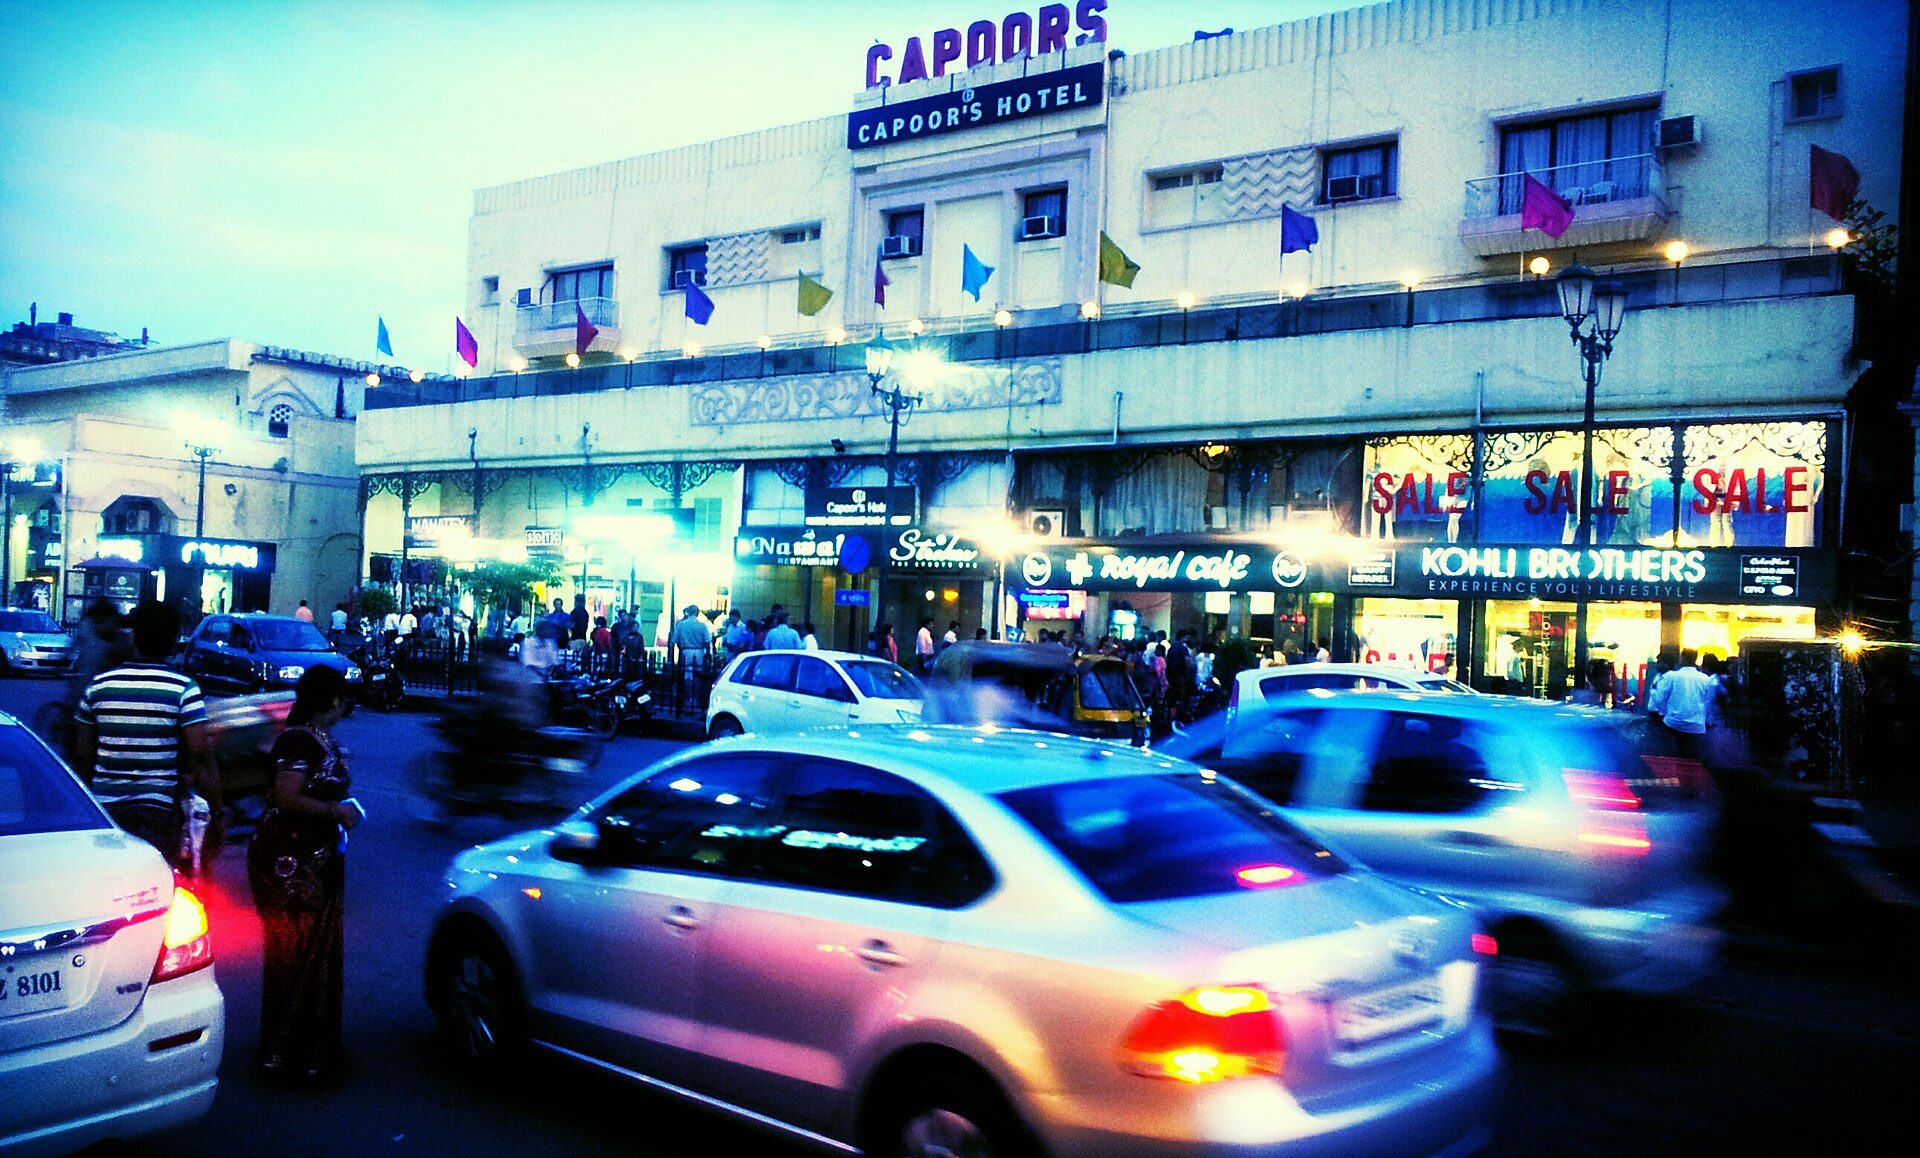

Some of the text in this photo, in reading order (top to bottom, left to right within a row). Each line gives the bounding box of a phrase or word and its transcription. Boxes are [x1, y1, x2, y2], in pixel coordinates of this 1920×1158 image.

[866, 0, 1108, 90] CAPOORS
[858, 82, 1087, 143] CAPOOR'S HOTEL
[1373, 471, 1467, 514] SALE
[1523, 470, 1629, 515] SAE
[1693, 467, 1808, 515] SALE
[1100, 550, 1185, 588] Royal
[1422, 546, 1516, 578] KOHLI
[1528, 547, 1706, 583] BROTHERS
[1429, 580, 1536, 594] EXPERIENCE
[1600, 583, 1695, 597] LIFESTYLE
[17, 970, 61, 997] 8101
